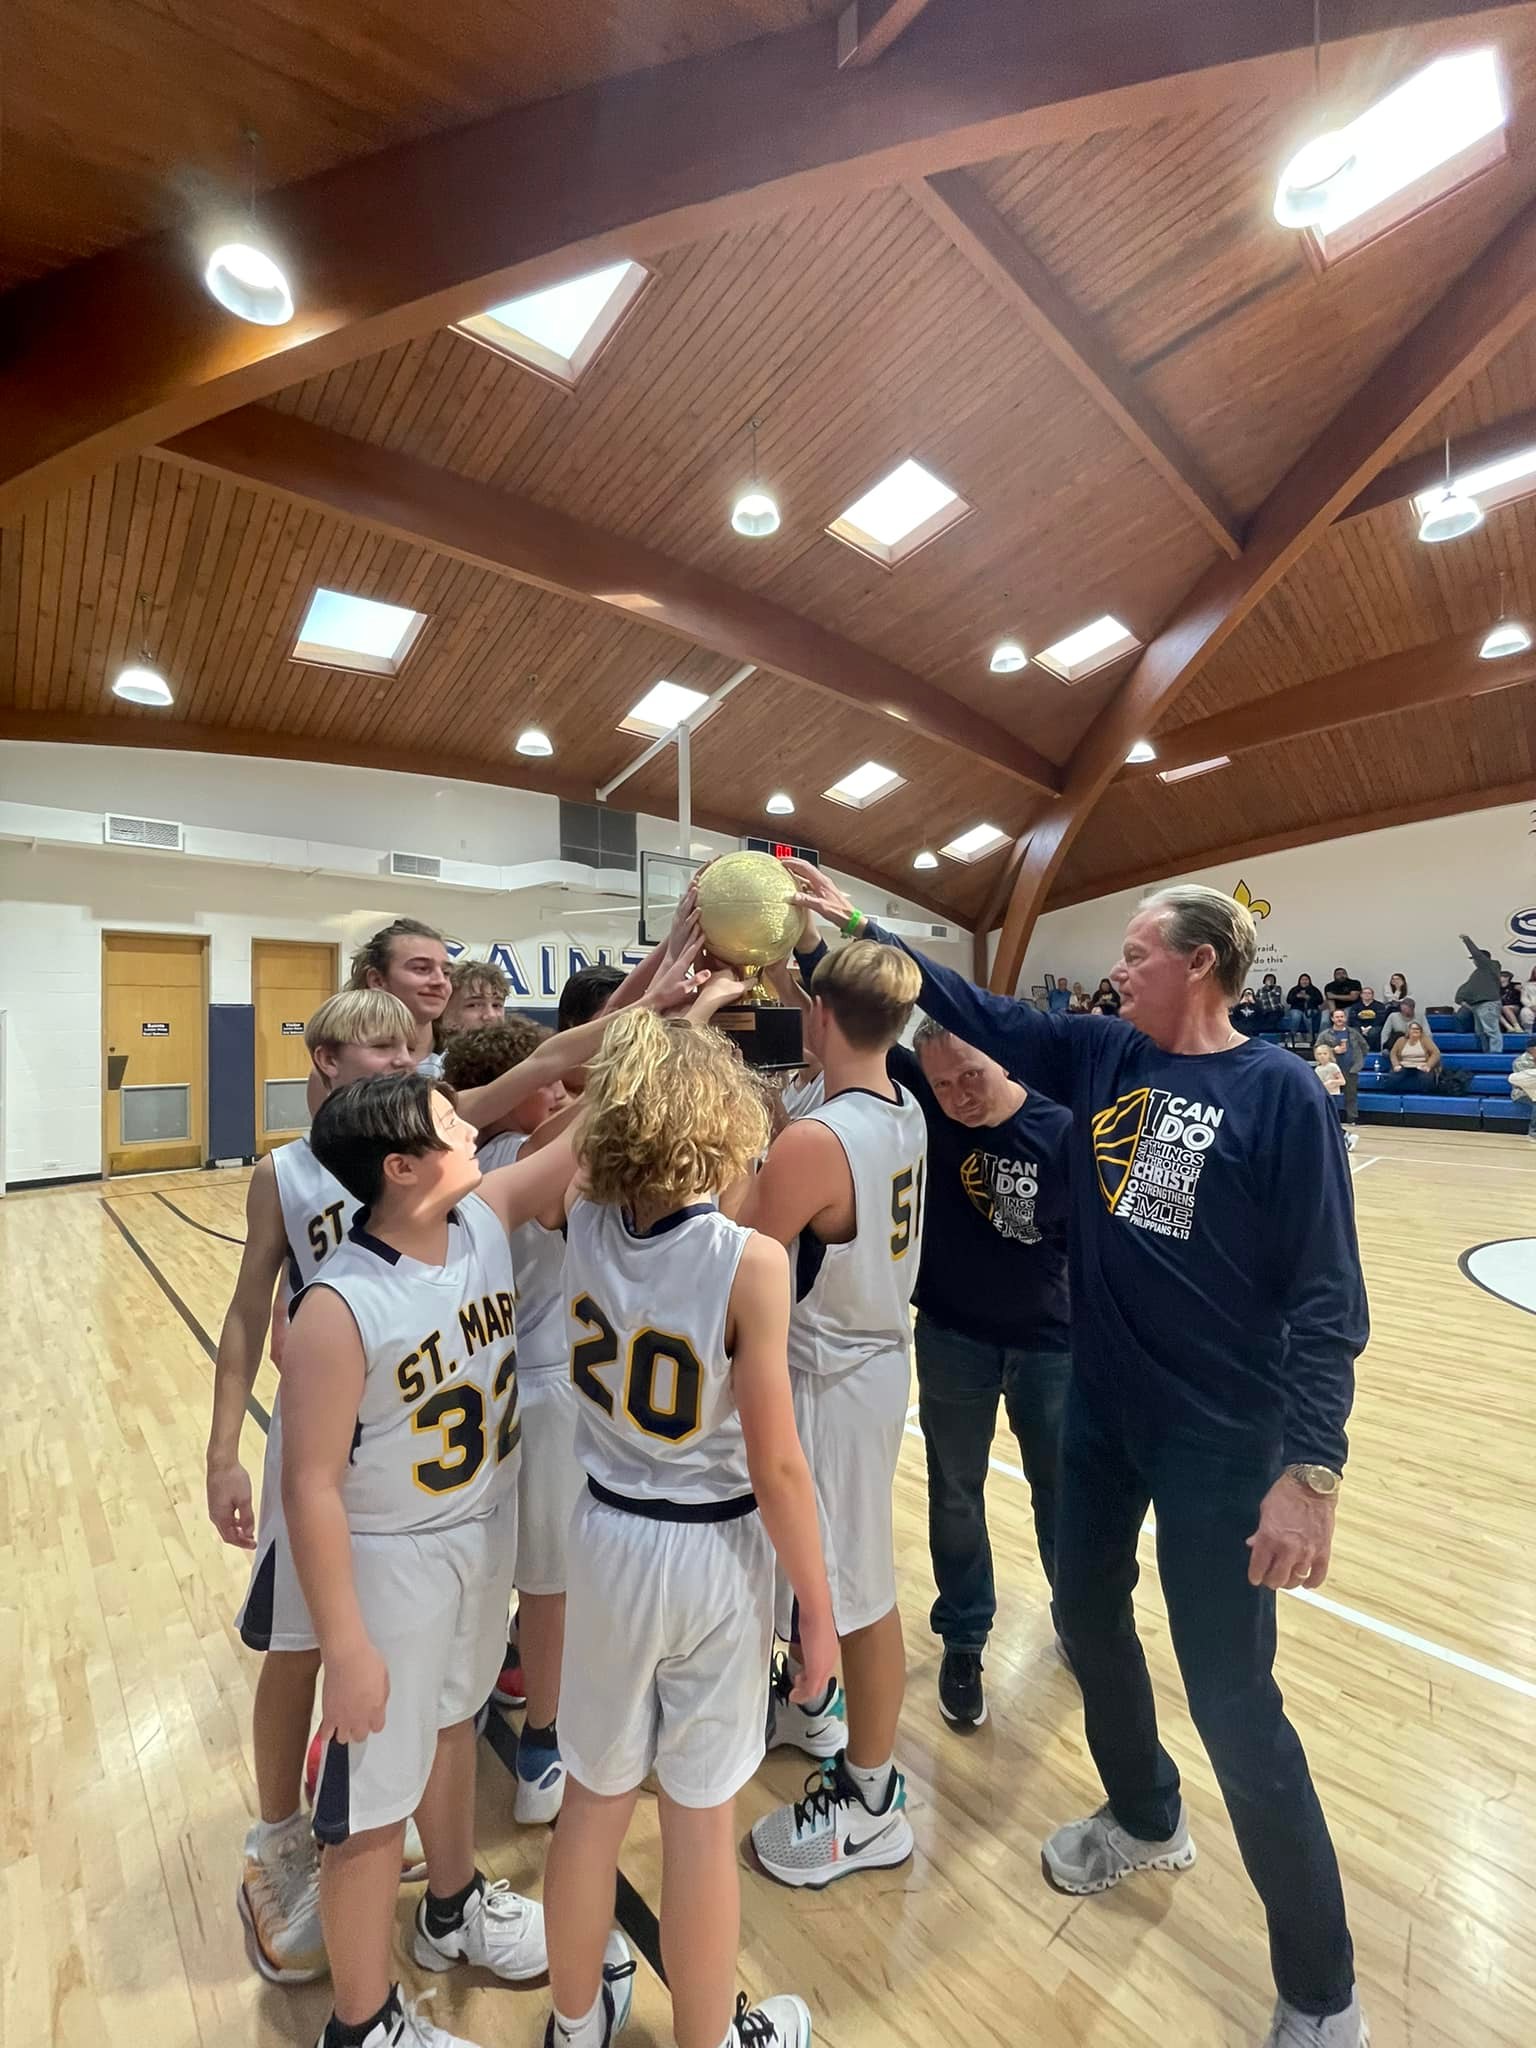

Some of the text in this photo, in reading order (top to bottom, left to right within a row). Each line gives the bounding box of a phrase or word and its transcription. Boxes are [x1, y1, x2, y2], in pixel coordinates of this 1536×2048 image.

[1141, 1088, 1224, 1139] I CAN
[1136, 1139, 1149, 1160] ALL
[1156, 1114, 1215, 1151] DO
[998, 1158, 1038, 1178] CAN
[1146, 1154, 1201, 1179] THROUGH
[1148, 1140, 1206, 1168] THINGS
[996, 1173, 1039, 1198] DO
[1131, 1160, 1197, 1195] CHRIST
[1139, 1181, 1196, 1208] STRENGTHENS
[889, 1154, 923, 1261] 51
[1114, 1179, 1139, 1217] WHO
[1133, 1193, 1193, 1229] ME
[1129, 1215, 1190, 1240] PHILIPPIANS 4:13
[397, 1329, 456, 1403] ST.
[570, 1290, 705, 1445] 20
[411, 1348, 522, 1496] 32
